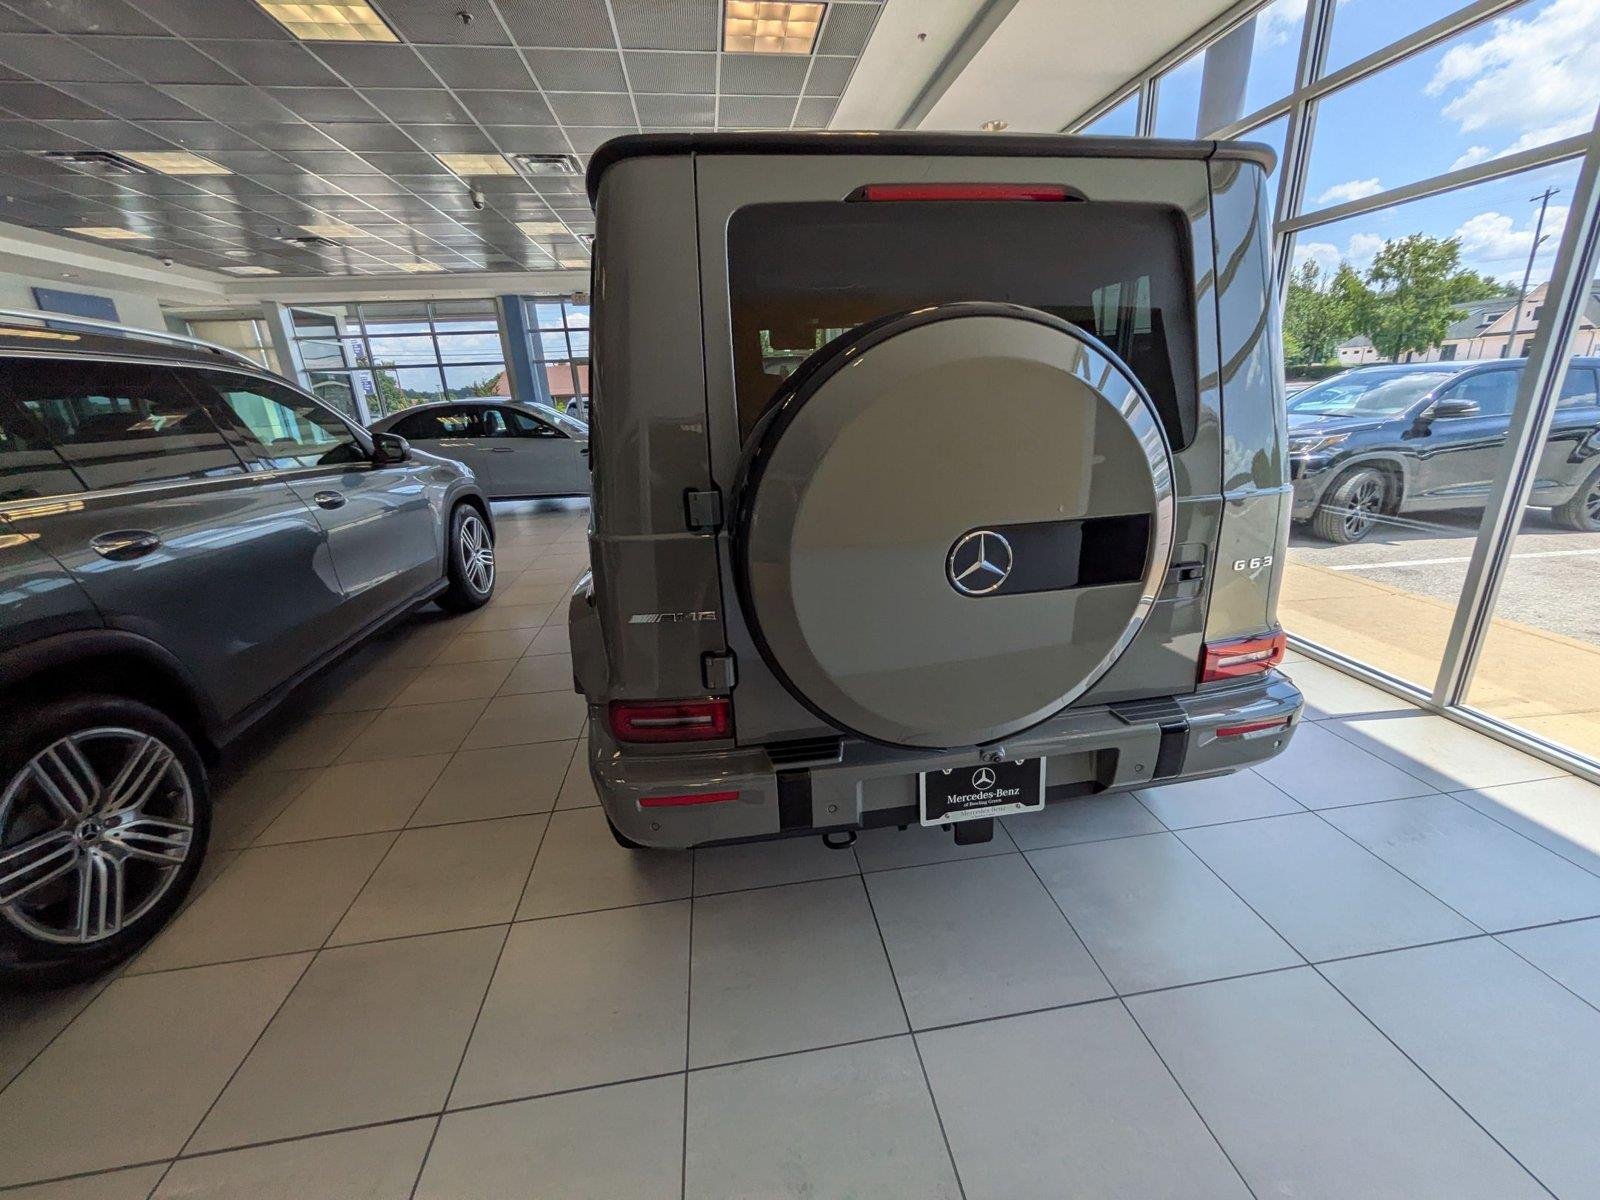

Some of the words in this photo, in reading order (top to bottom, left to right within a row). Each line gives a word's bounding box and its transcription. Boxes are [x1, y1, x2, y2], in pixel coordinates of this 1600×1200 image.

[1233, 560, 1246, 571] G
[1250, 555, 1273, 569] 63
[947, 788, 1020, 804] Mercedes-Benz
